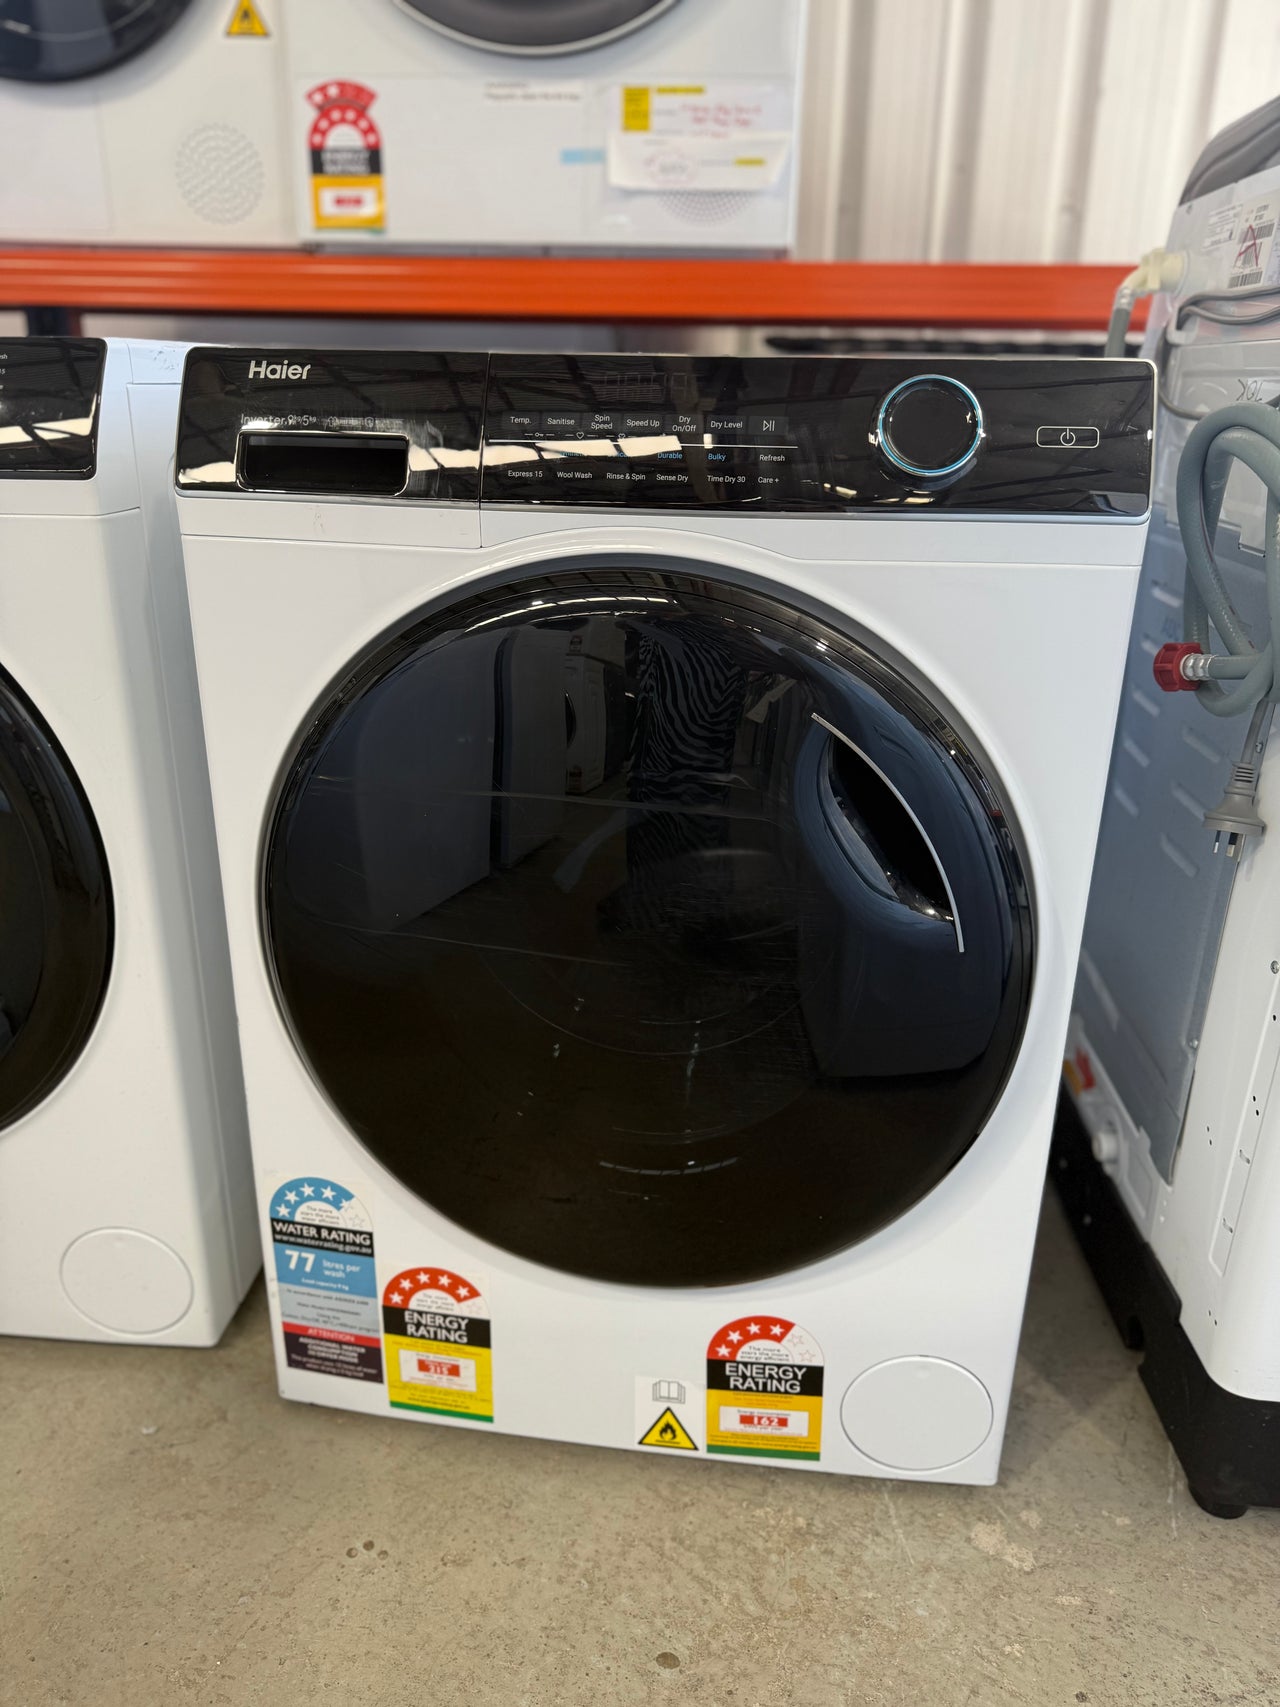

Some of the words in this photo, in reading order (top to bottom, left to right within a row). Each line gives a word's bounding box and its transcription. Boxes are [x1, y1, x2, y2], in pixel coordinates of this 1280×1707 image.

[248, 360, 311, 380] Haier
[510, 416, 532, 425] Temp.
[547, 417, 575, 425] Sanitise
[594, 414, 610, 423] Spin
[678, 415, 691, 424] Dry
[591, 422, 613, 430] Speed
[626, 419, 648, 428] Speed
[649, 420, 660, 428] Up
[672, 424, 697, 432] On/Off
[710, 420, 722, 429] Dry
[707, 453, 726, 462] Bulky
[759, 454, 786, 462] Refresh
[508, 470, 533, 478] Express
[534, 470, 543, 478] 15
[574, 471, 592, 479] Wash
[606, 472, 624, 480] Rinse
[631, 473, 646, 481] Spin
[677, 474, 689, 482] Dry
[725, 475, 737, 484] Dry
[273, 1221, 319, 1238] WATER
[320, 1229, 371, 1246] RATING
[274, 1234, 372, 1254] www.waterrating.gov.au
[285, 1249, 316, 1273] 77
[322, 1260, 344, 1270] litres
[346, 1264, 360, 1273] per
[323, 1269, 346, 1279] wash
[404, 1311, 469, 1331] ENERGY
[307, 1328, 356, 1343] ATTENTION
[406, 1323, 468, 1344] RATING
[725, 1362, 808, 1380] ENERGY
[729, 1376, 801, 1394] RATING
[753, 1416, 779, 1426] 162
